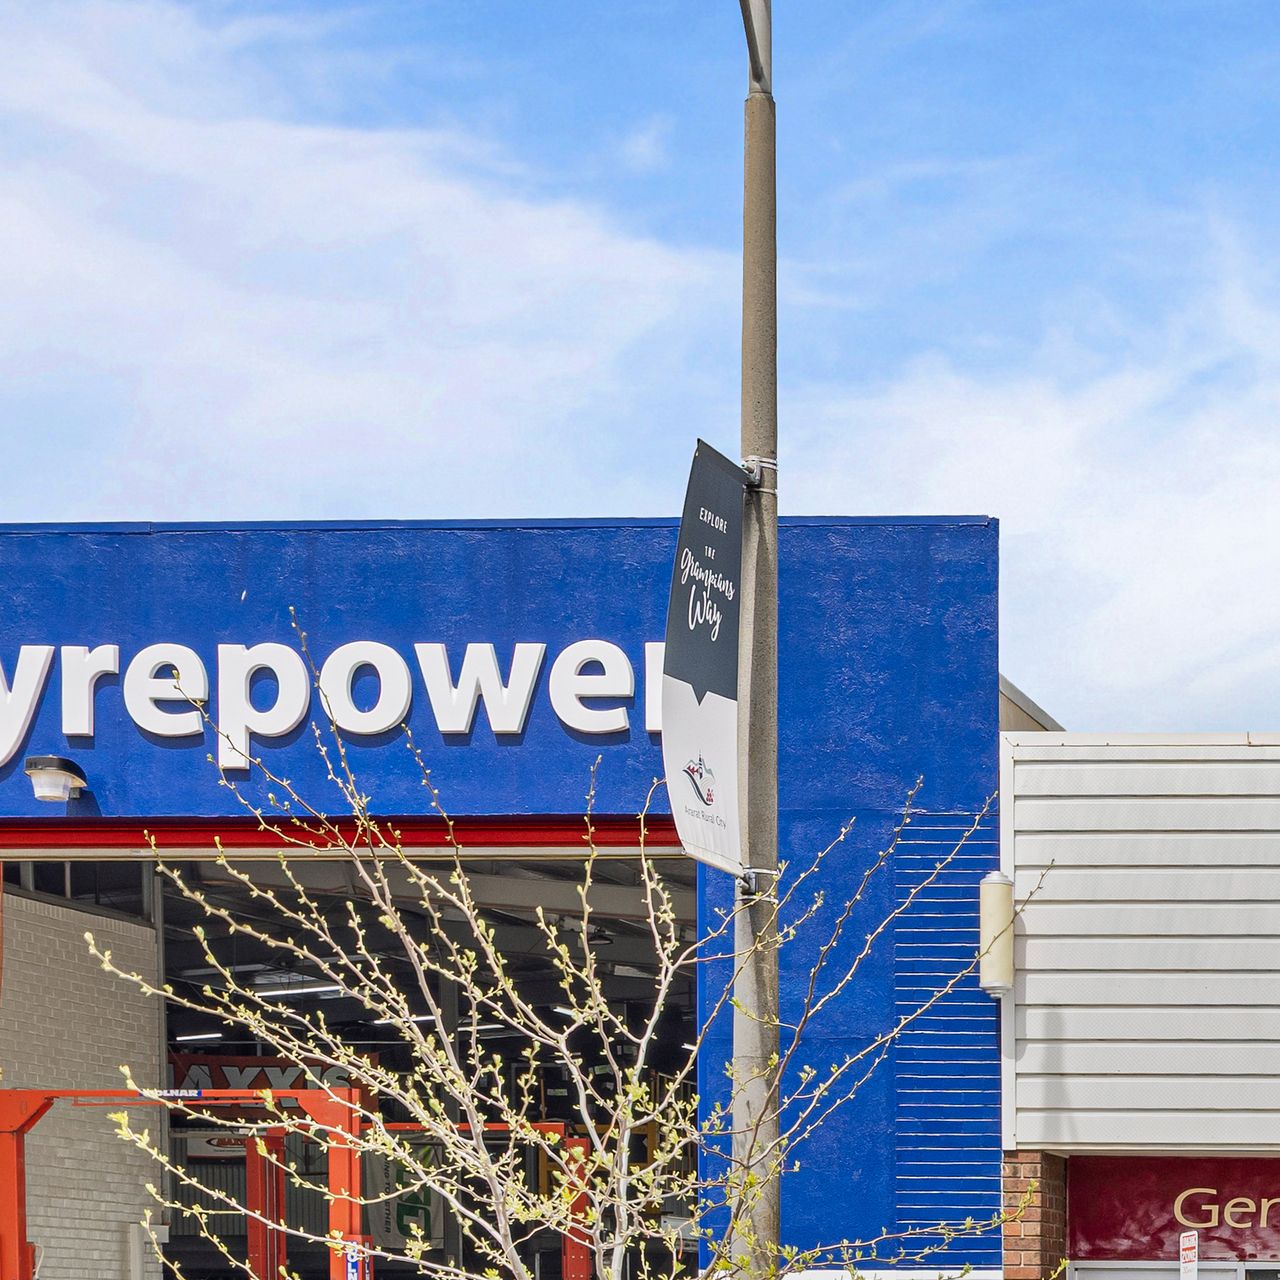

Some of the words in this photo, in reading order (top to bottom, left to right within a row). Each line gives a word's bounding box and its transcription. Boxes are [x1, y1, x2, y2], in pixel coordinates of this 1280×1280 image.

[699, 507, 728, 534] EXPLORE
[704, 545, 716, 560] THE
[688, 584, 723, 642] Way
[715, 815, 727, 830] City
